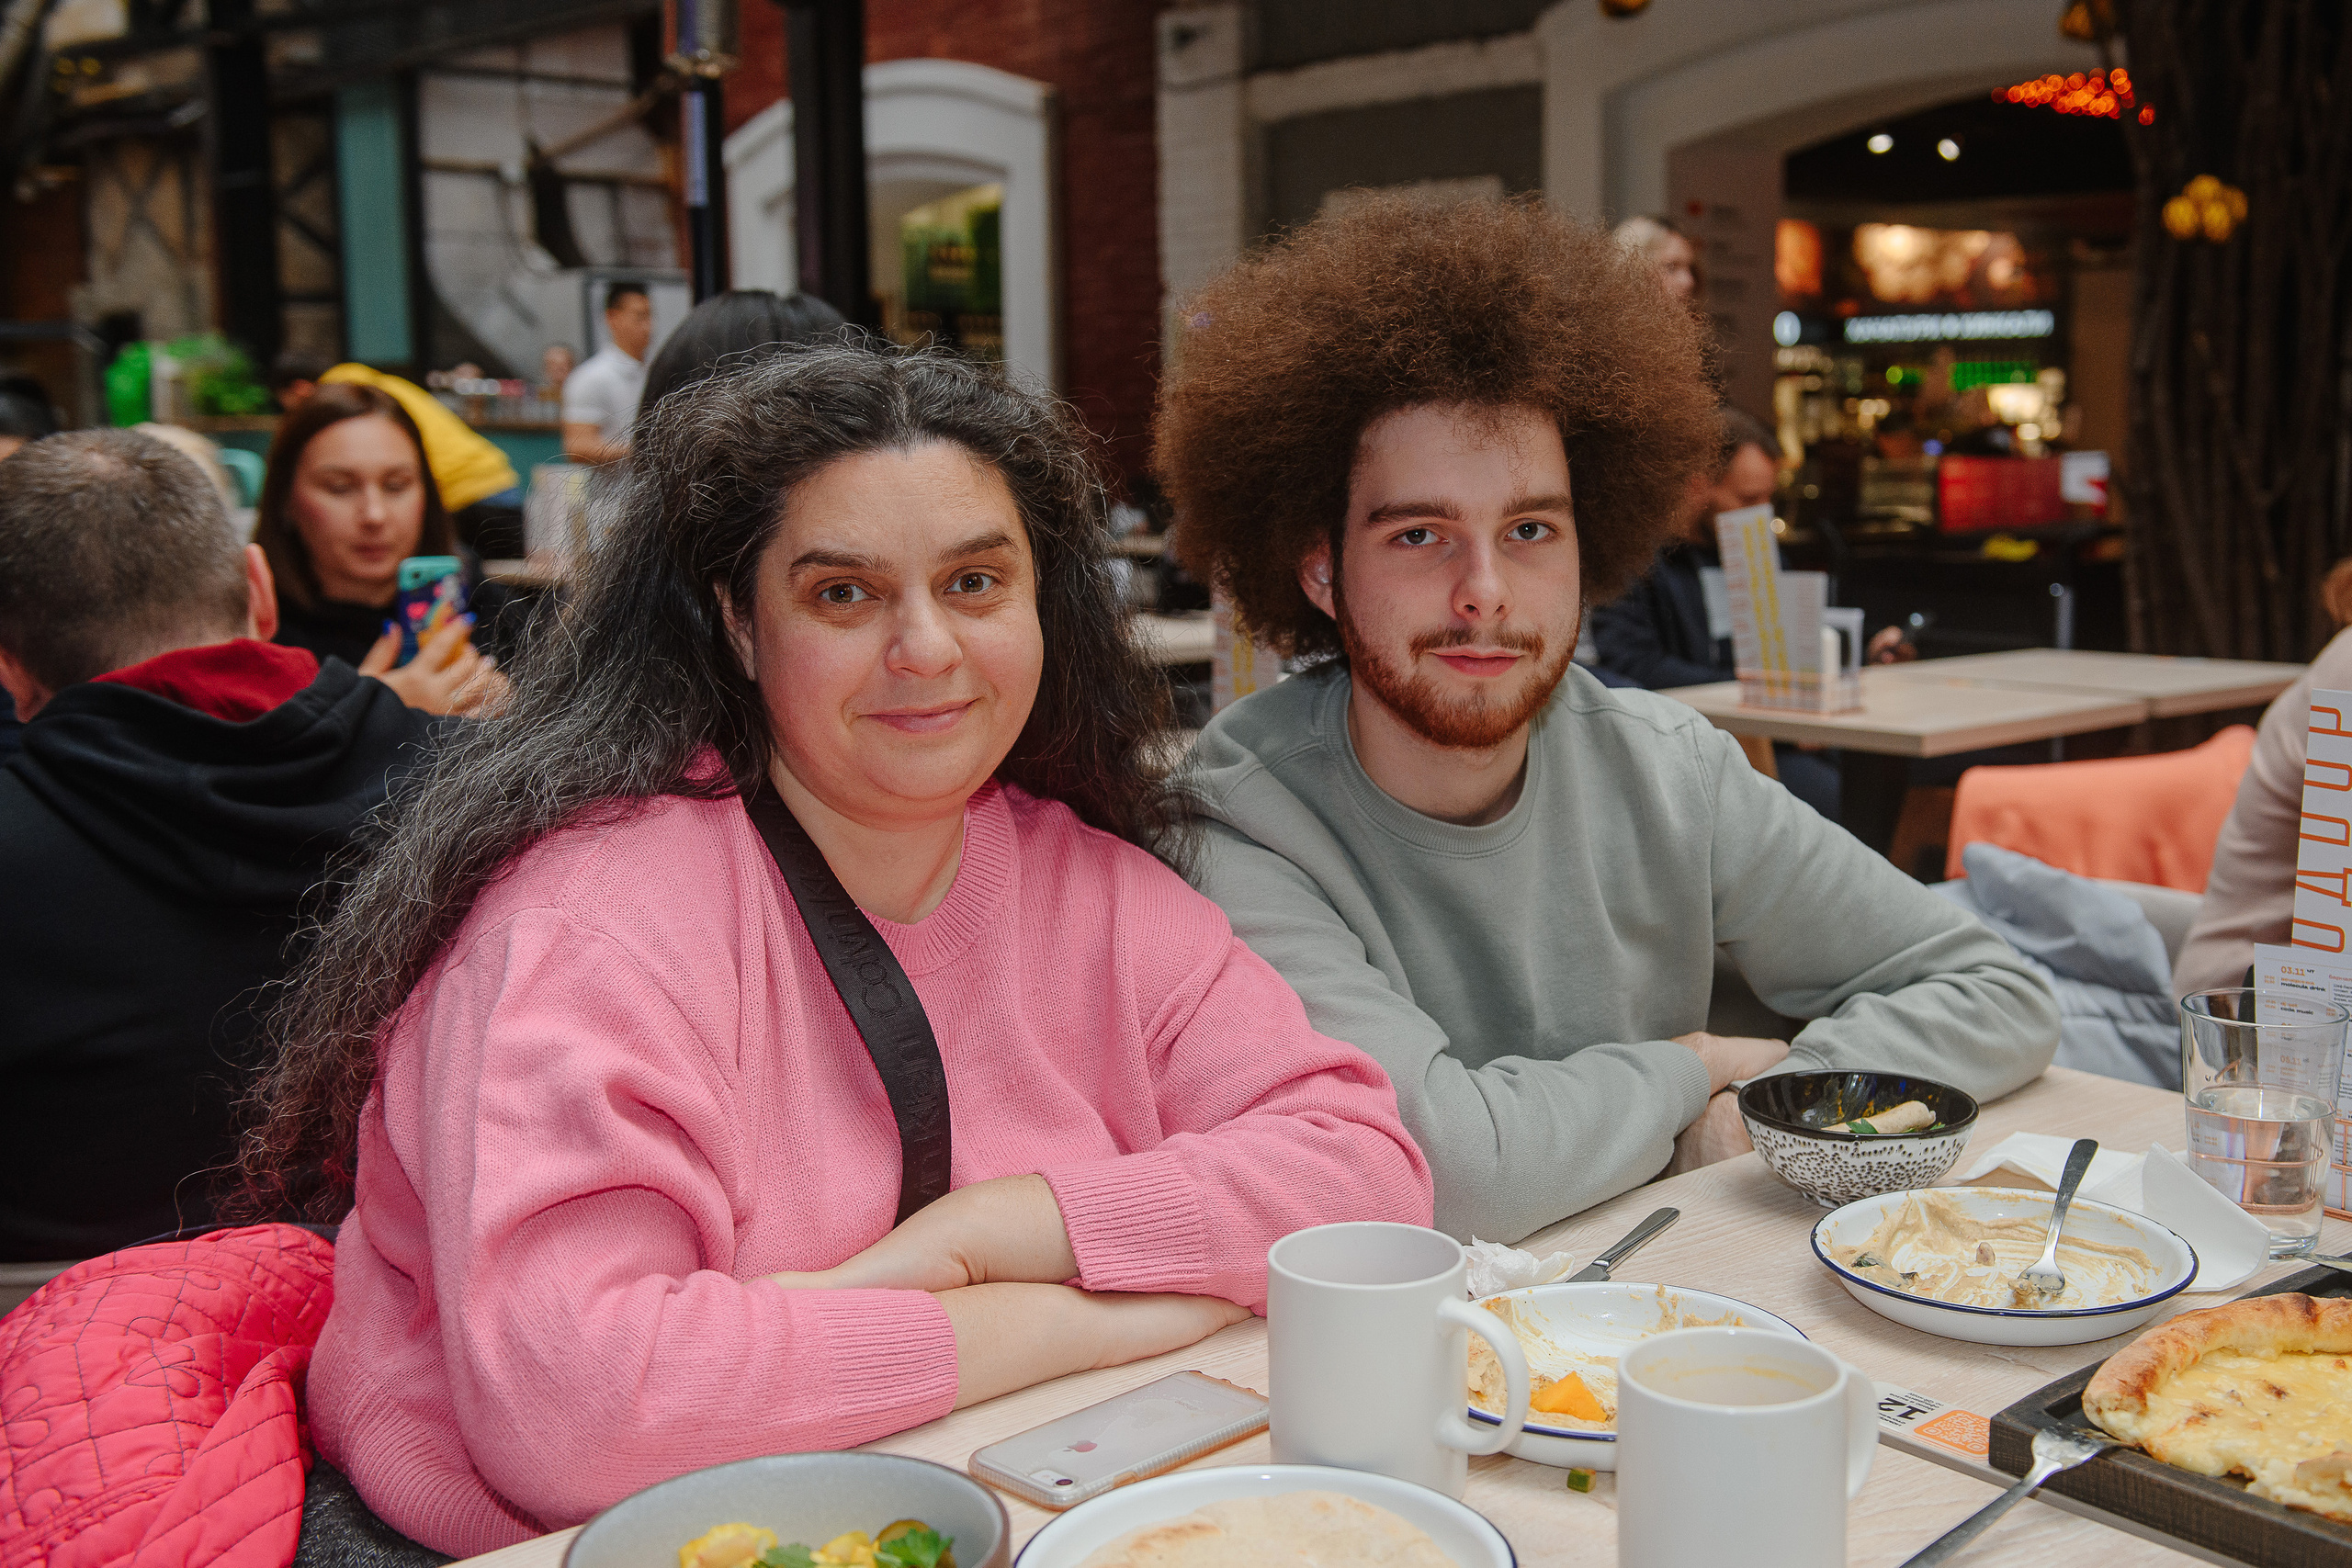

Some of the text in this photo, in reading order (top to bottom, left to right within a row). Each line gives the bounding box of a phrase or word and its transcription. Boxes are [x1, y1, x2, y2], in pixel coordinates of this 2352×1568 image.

[824, 908, 904, 1020] Calvin
[2280, 965, 2305, 976] 03.11
[1878, 1397, 1928, 1420] 12
